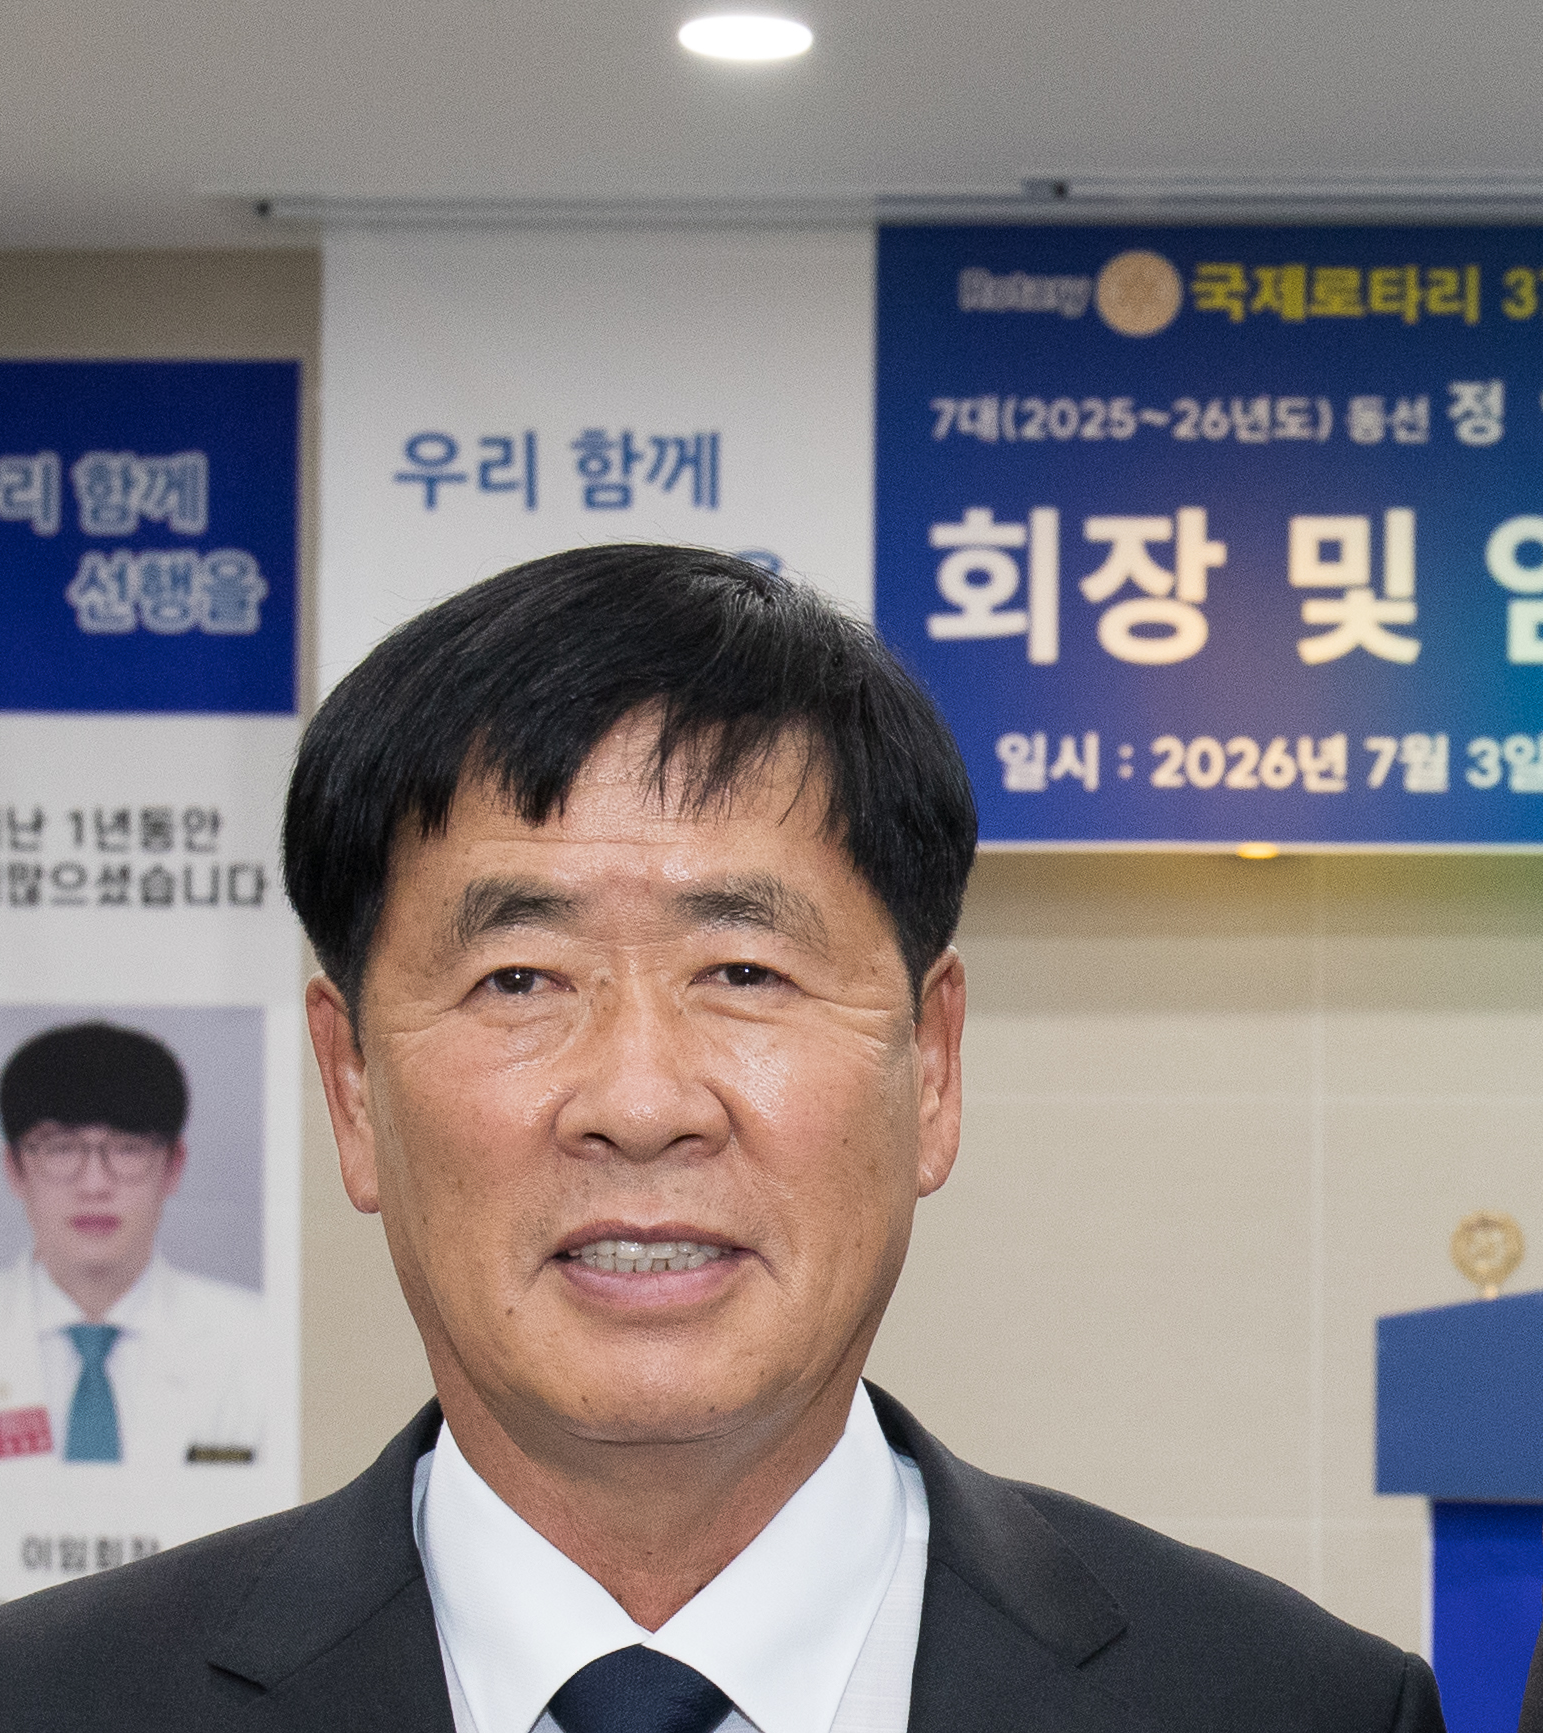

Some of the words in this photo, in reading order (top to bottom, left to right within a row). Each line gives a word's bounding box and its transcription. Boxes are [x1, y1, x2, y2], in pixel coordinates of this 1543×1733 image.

[1193, 264, 1481, 324] 국제로타리
[930, 396, 1332, 446] 7대(2025~26년도)
[1450, 380, 1505, 449] 정
[70, 450, 209, 535] 함께
[394, 428, 540, 512] 우리
[570, 428, 721, 511] 함께
[65, 548, 267, 634] 선행을
[927, 506, 1227, 668] 회장
[1285, 507, 1423, 668] 및
[995, 731, 1099, 793] 일시
[1150, 732, 1350, 794] 2026년
[1364, 733, 1449, 794] 7월
[66, 804, 223, 855] 1년동안
